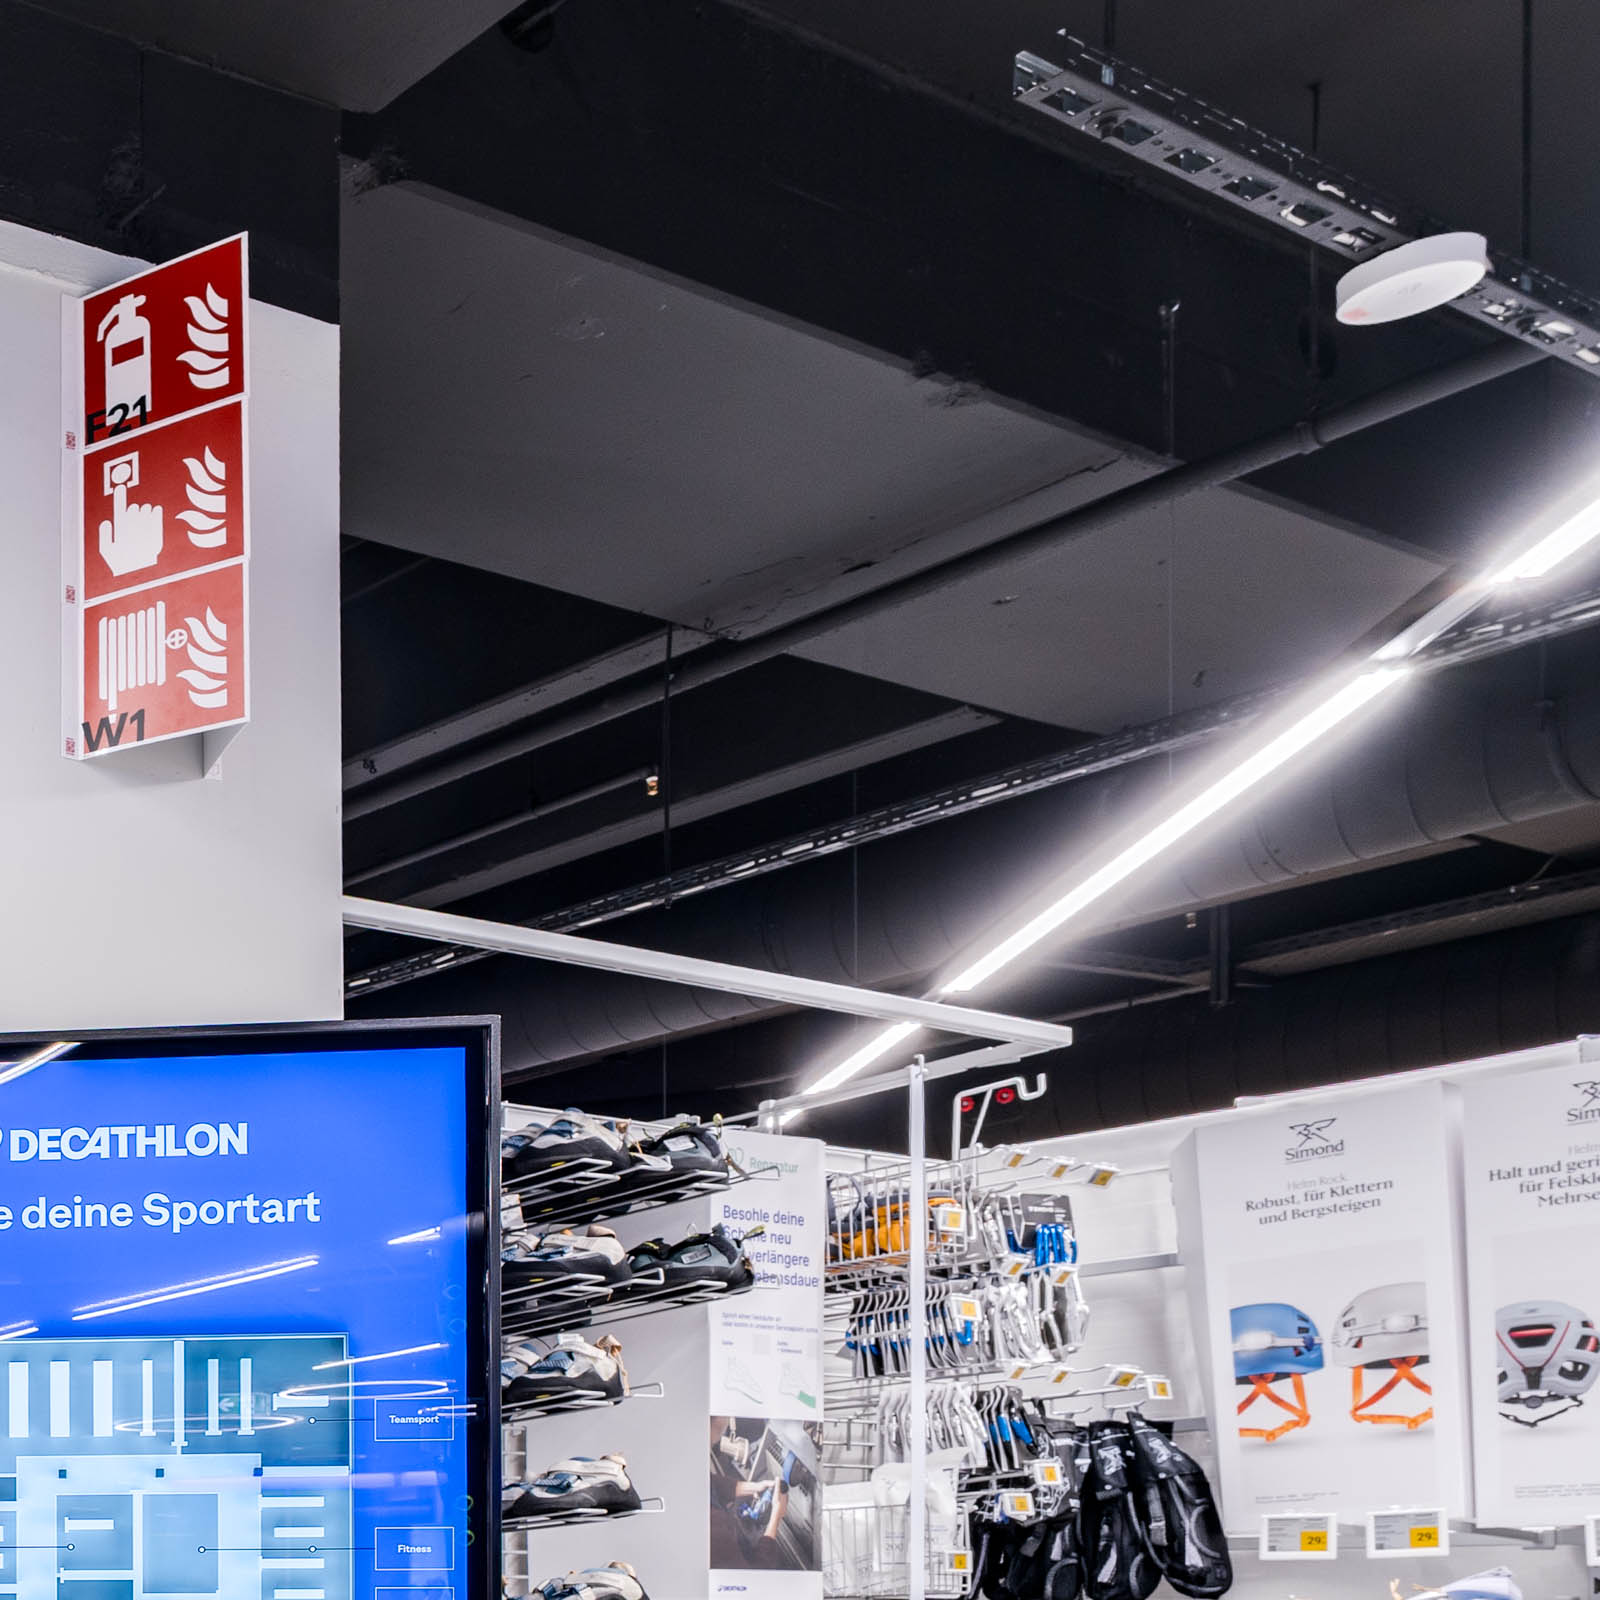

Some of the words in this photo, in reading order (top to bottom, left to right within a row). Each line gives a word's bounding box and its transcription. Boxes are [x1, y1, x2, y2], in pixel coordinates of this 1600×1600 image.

[86, 395, 148, 446] F21
[82, 708, 146, 752] W1
[9, 1122, 248, 1161] DECATHLON
[1284, 1139, 1345, 1161] Simond
[1489, 1166, 1522, 1182] Halt
[1528, 1160, 1561, 1177] und
[1303, 1189, 1325, 1203] für
[1329, 1179, 1394, 1199] Klettern
[1519, 1181, 1544, 1194] für
[21, 1196, 133, 1228] deine
[141, 1191, 321, 1233] Sportart
[723, 1205, 770, 1223] Besohle
[773, 1210, 805, 1226] deine
[1259, 1211, 1288, 1225] und
[1291, 1197, 1381, 1220] Bergsteigen
[770, 1232, 792, 1245] neu
[389, 1415, 439, 1425] Teamsport
[397, 1545, 431, 1553] Fitness
